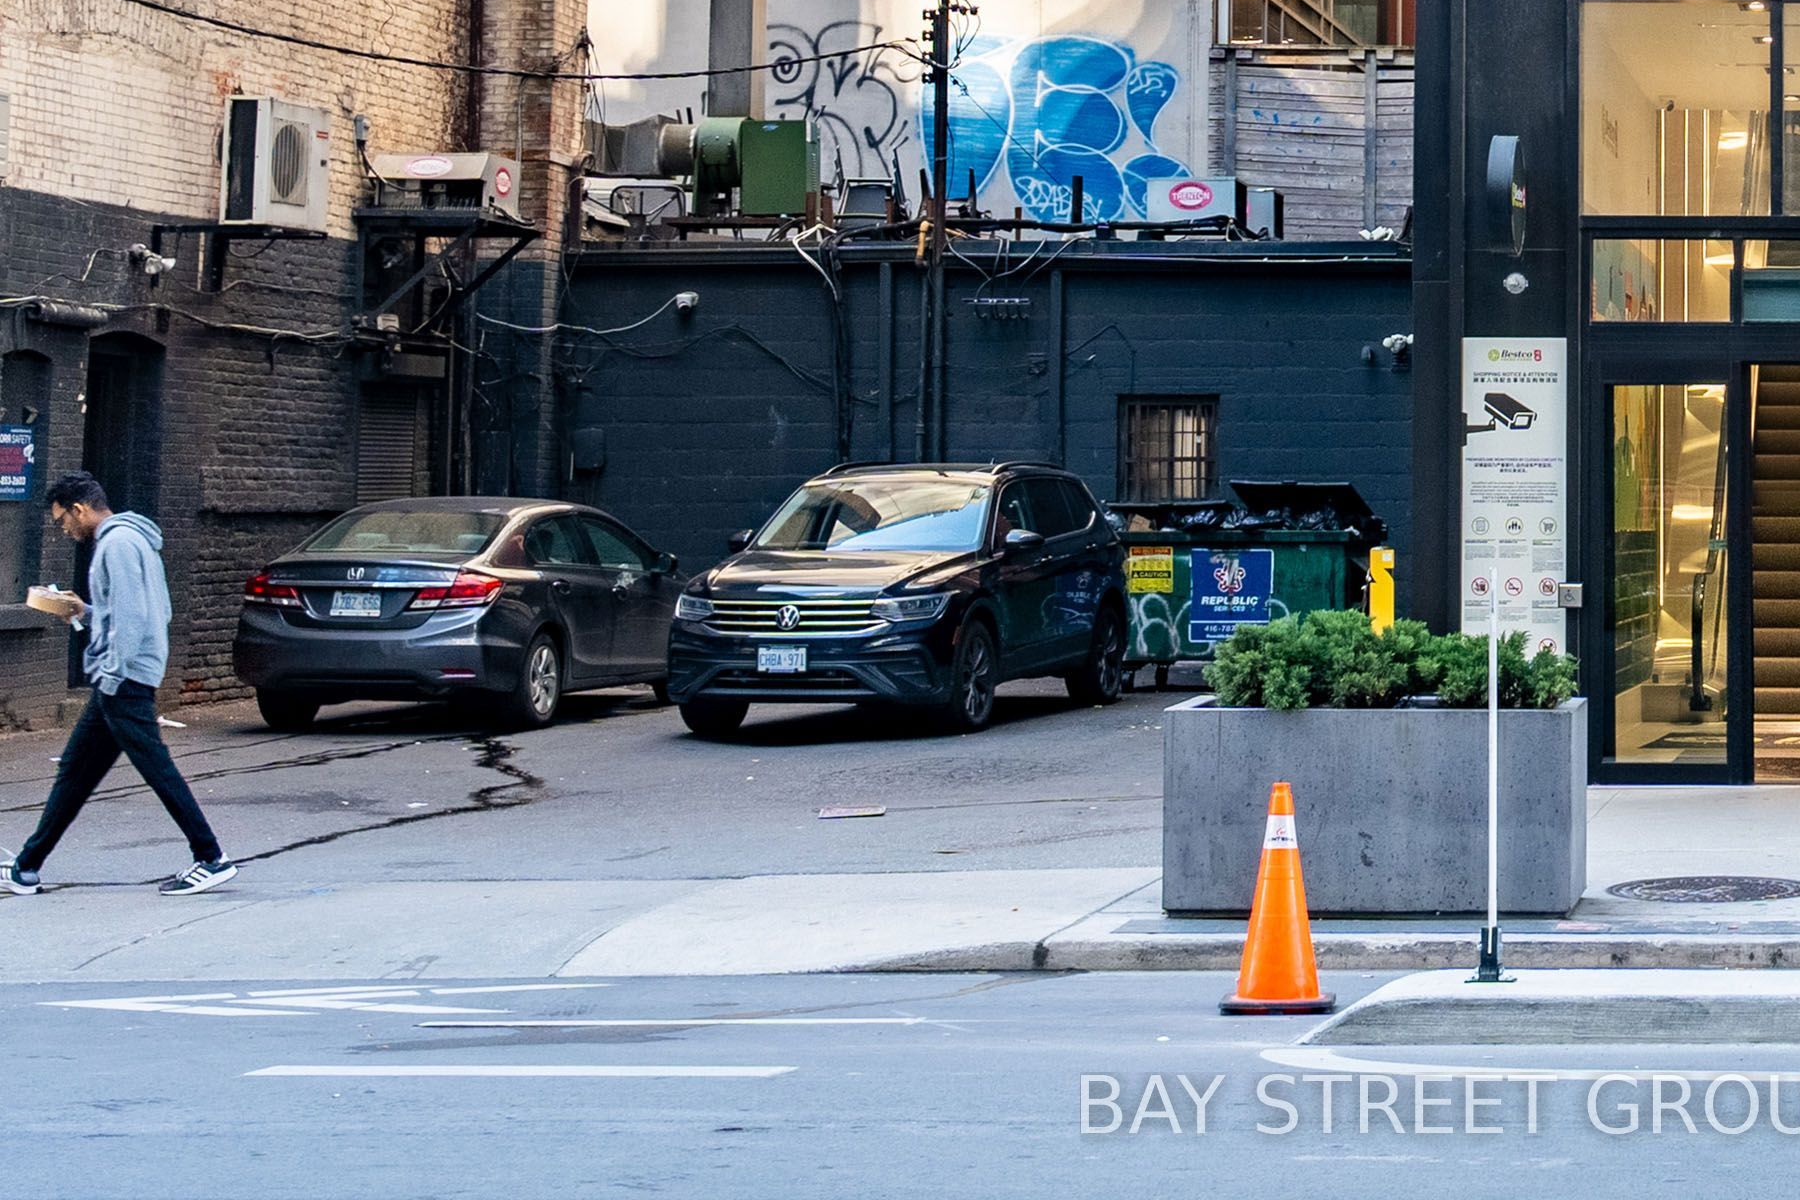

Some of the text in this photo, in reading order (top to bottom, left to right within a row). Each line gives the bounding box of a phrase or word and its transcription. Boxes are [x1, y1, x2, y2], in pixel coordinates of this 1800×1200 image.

[1501, 349, 1533, 358] Bestco
[760, 653, 805, 666] CHBA 971
